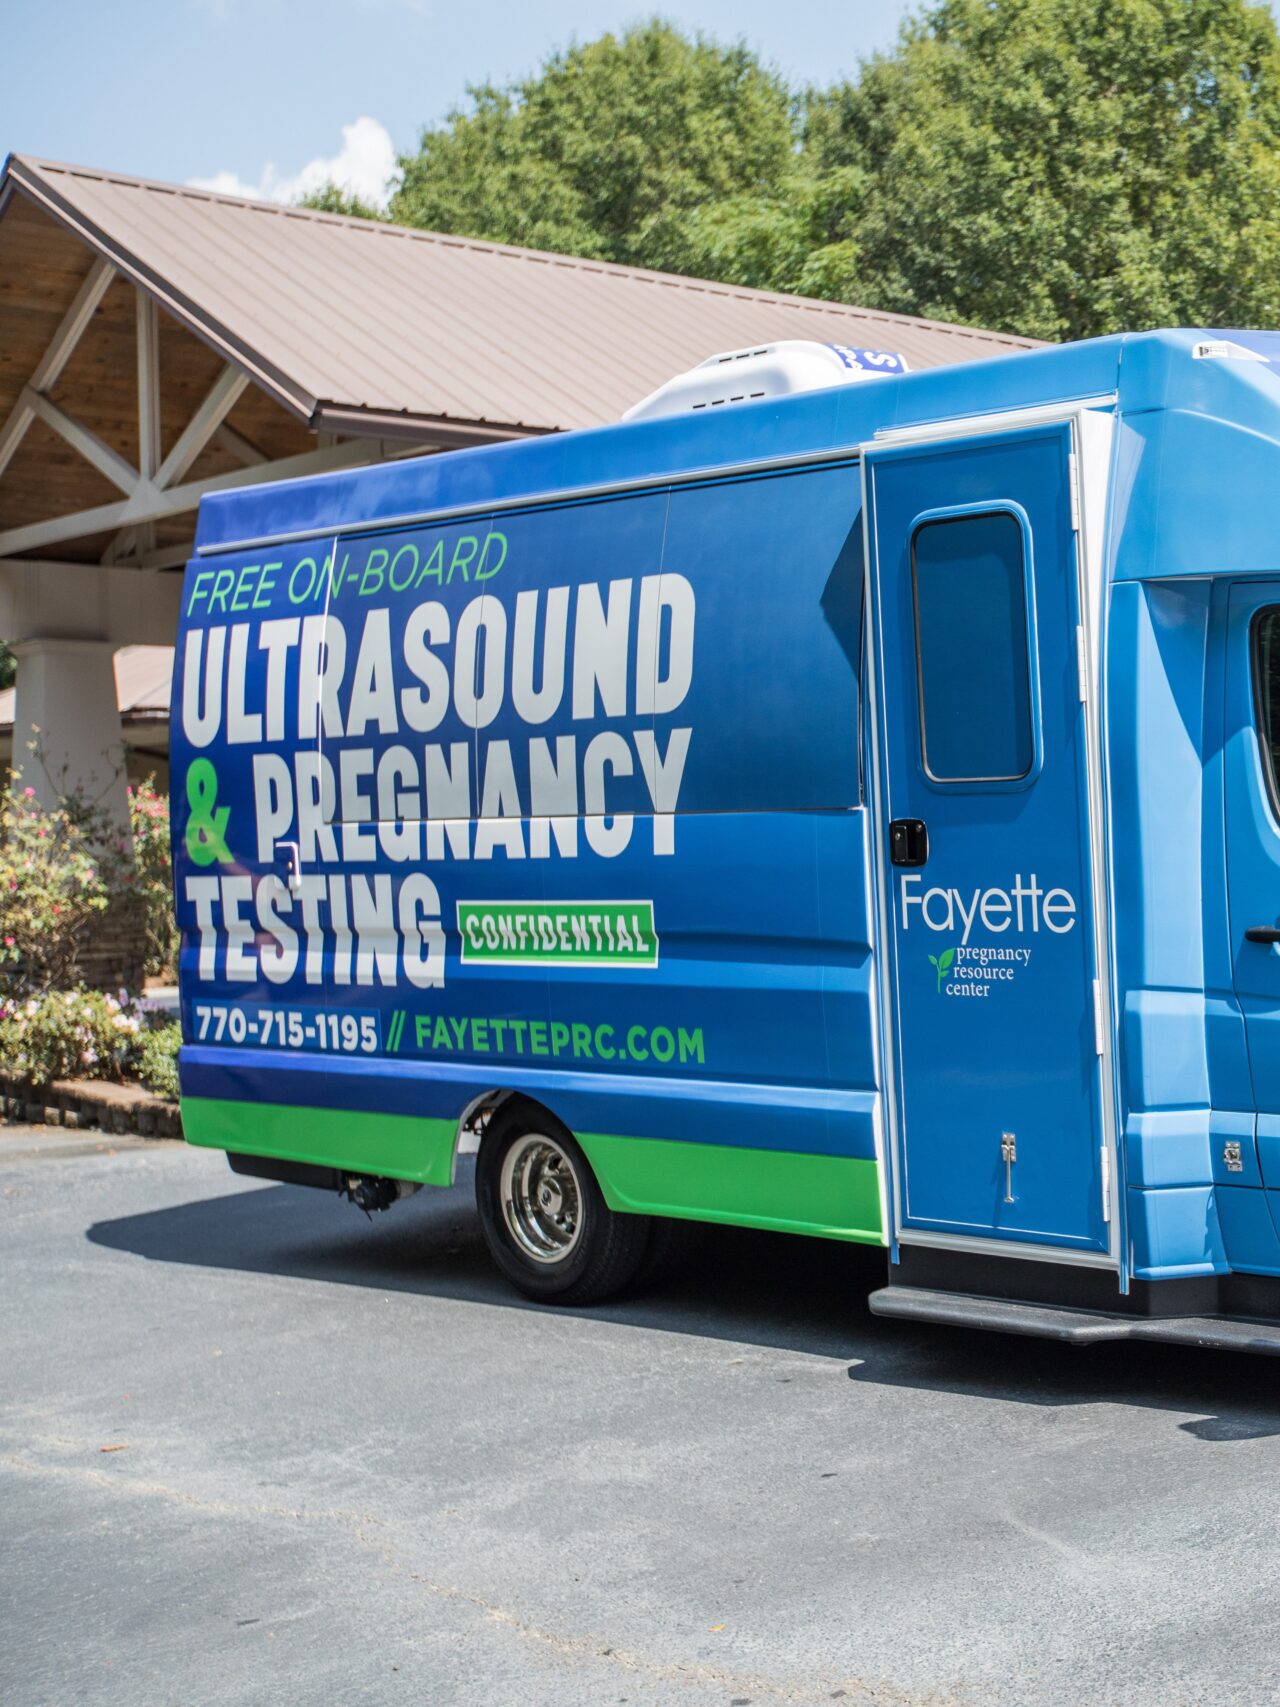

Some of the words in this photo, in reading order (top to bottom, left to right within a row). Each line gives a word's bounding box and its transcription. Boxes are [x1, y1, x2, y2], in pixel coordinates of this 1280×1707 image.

[186, 561, 284, 617] FREE
[288, 532, 508, 606] ON-BOARD
[182, 572, 696, 748] ULTRASOUND
[185, 756, 235, 867] &
[252, 727, 694, 865] PREGNANCY
[184, 872, 446, 989] TESTING
[465, 913, 650, 953] CONFIDENTIAL
[900, 873, 1077, 945] Fayette
[945, 983, 990, 997] center
[953, 966, 1015, 980] resource
[956, 947, 1031, 967] pregnancy
[195, 1005, 379, 1053] 770-715-1195
[414, 1014, 706, 1065] FAYETTEPRC.COM
